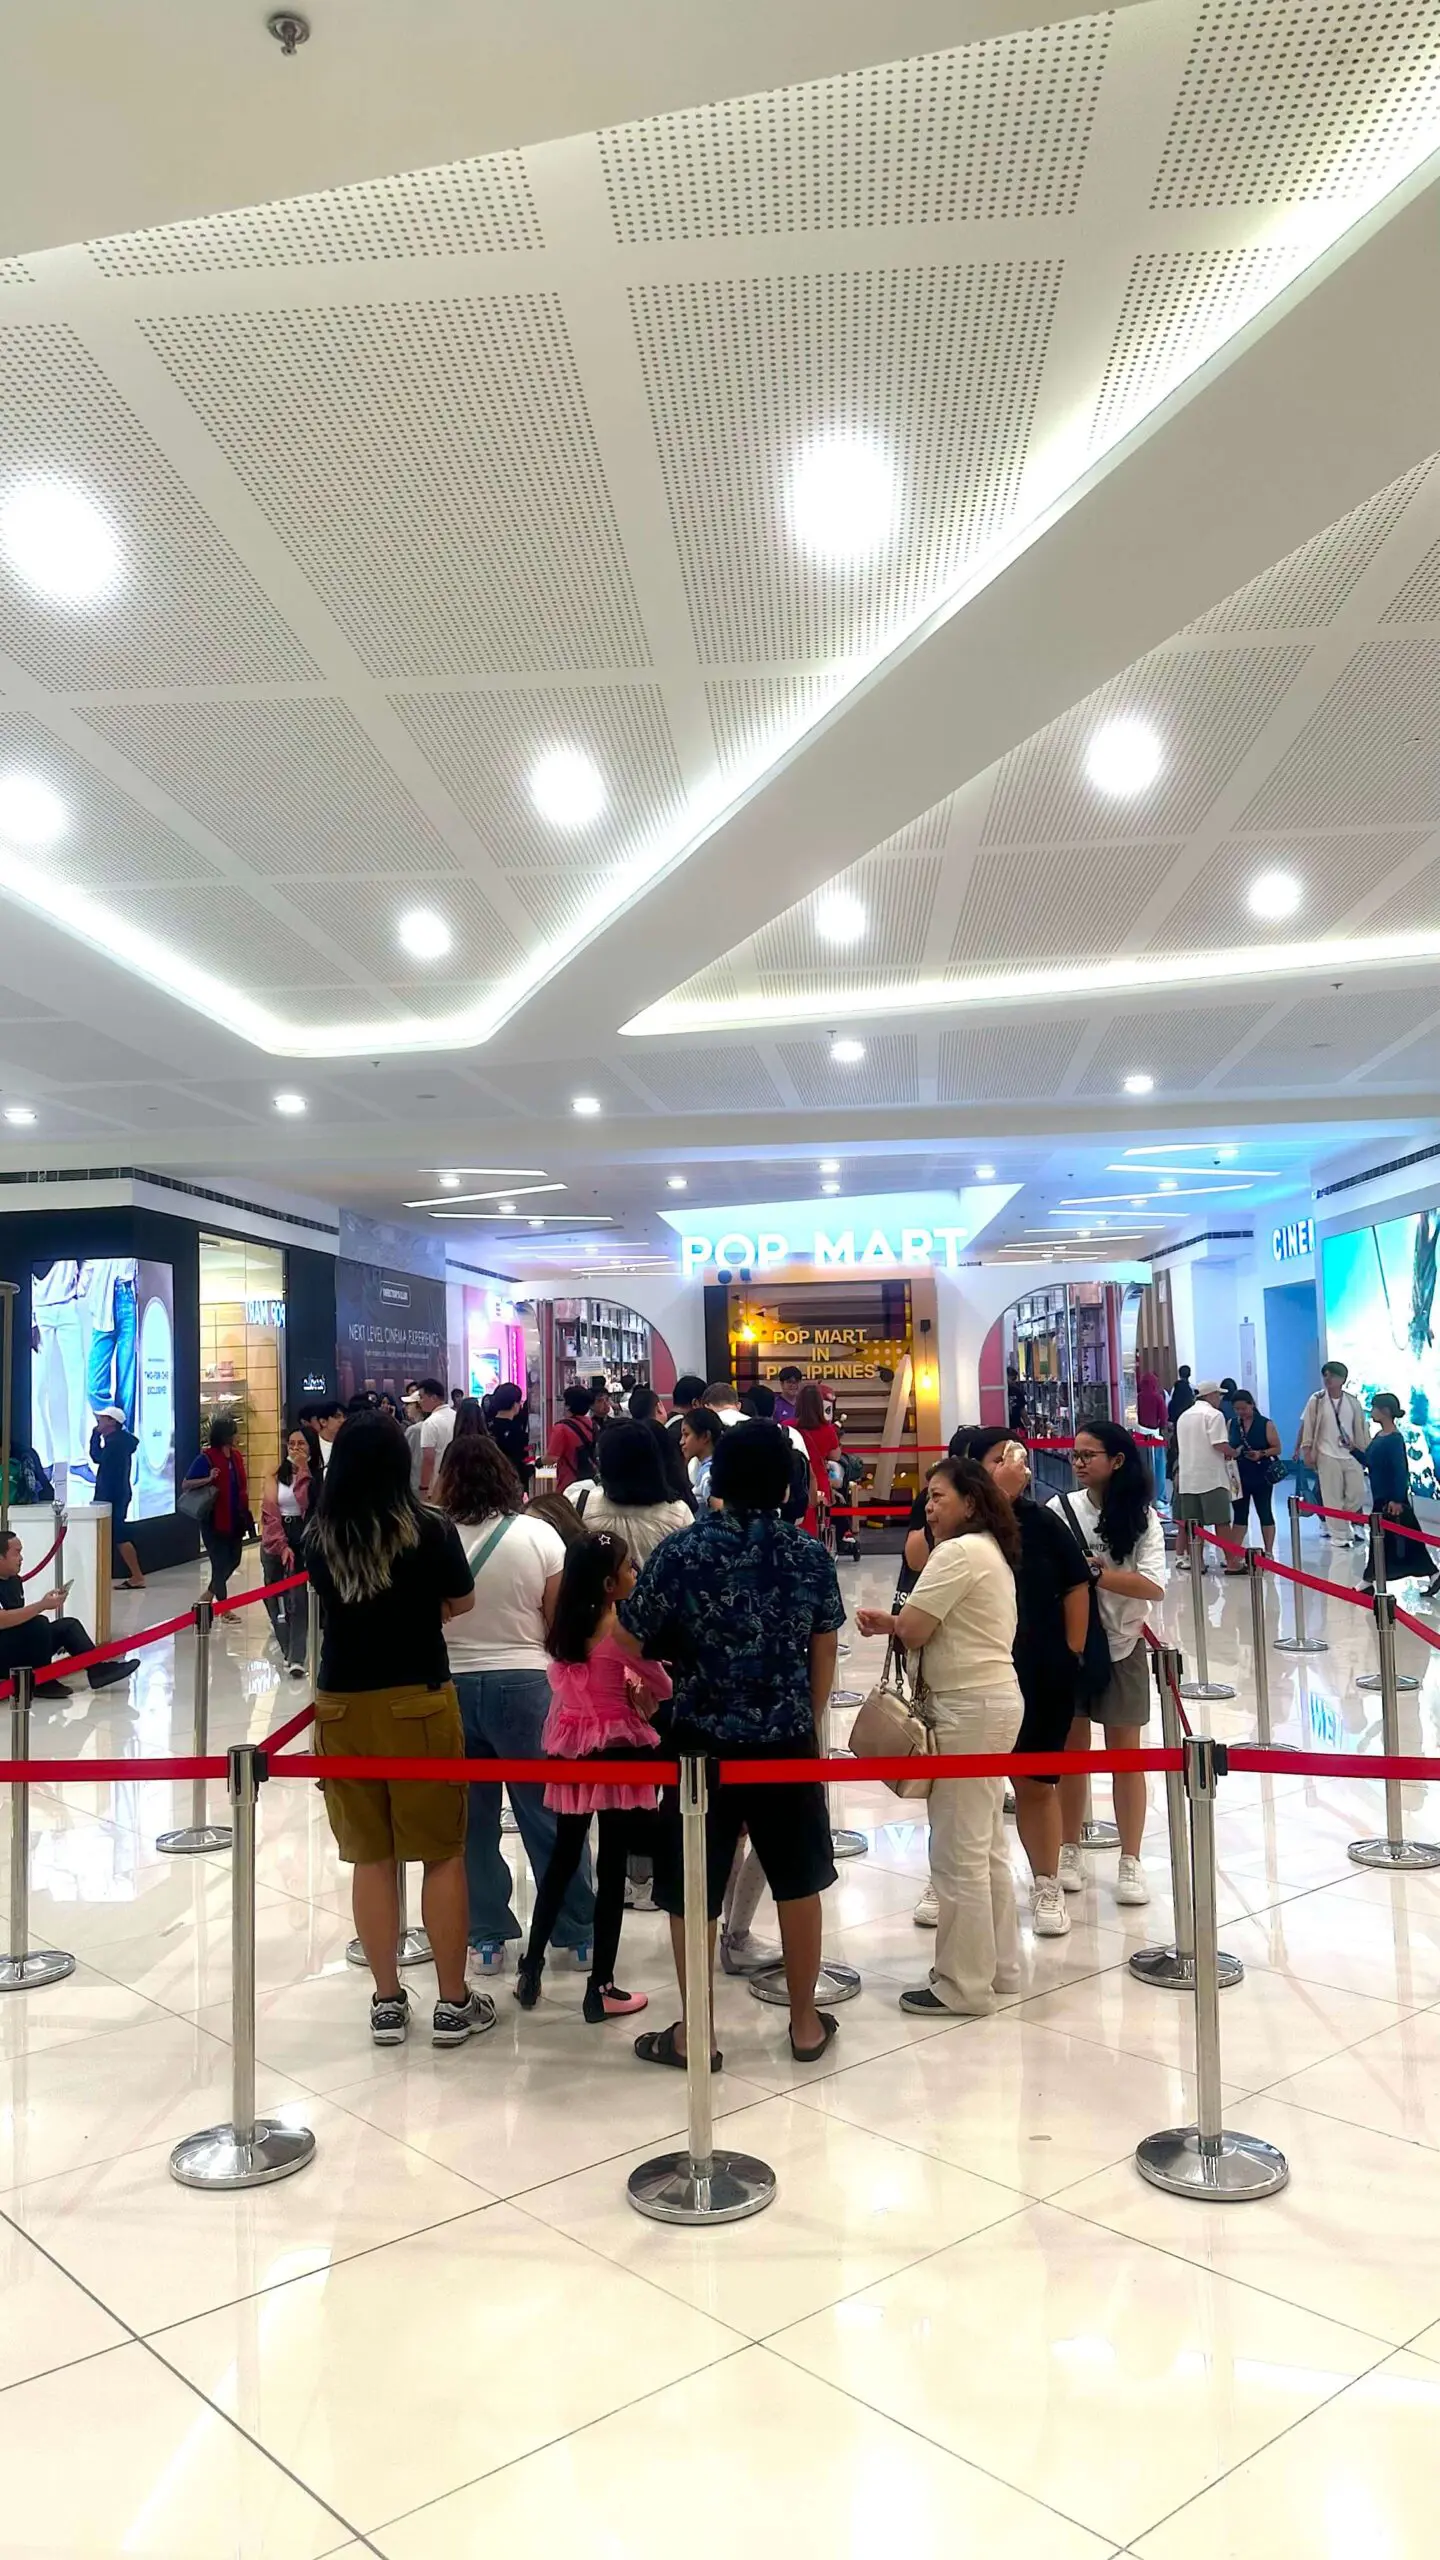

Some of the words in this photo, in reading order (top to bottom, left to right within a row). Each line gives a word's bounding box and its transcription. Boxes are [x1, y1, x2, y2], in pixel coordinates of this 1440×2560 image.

[682, 1233, 788, 1277] POP
[814, 1227, 968, 1268] MART
[348, 1324, 366, 1342] NEXT
[367, 1325, 384, 1343] LEVEL
[385, 1327, 407, 1344] CINEMA
[408, 1329, 440, 1347] EXPERIENCE
[773, 1330, 810, 1344] POP
[814, 1329, 867, 1344] MART
[812, 1347, 830, 1361] IN
[766, 1363, 876, 1380] PIPPINES
